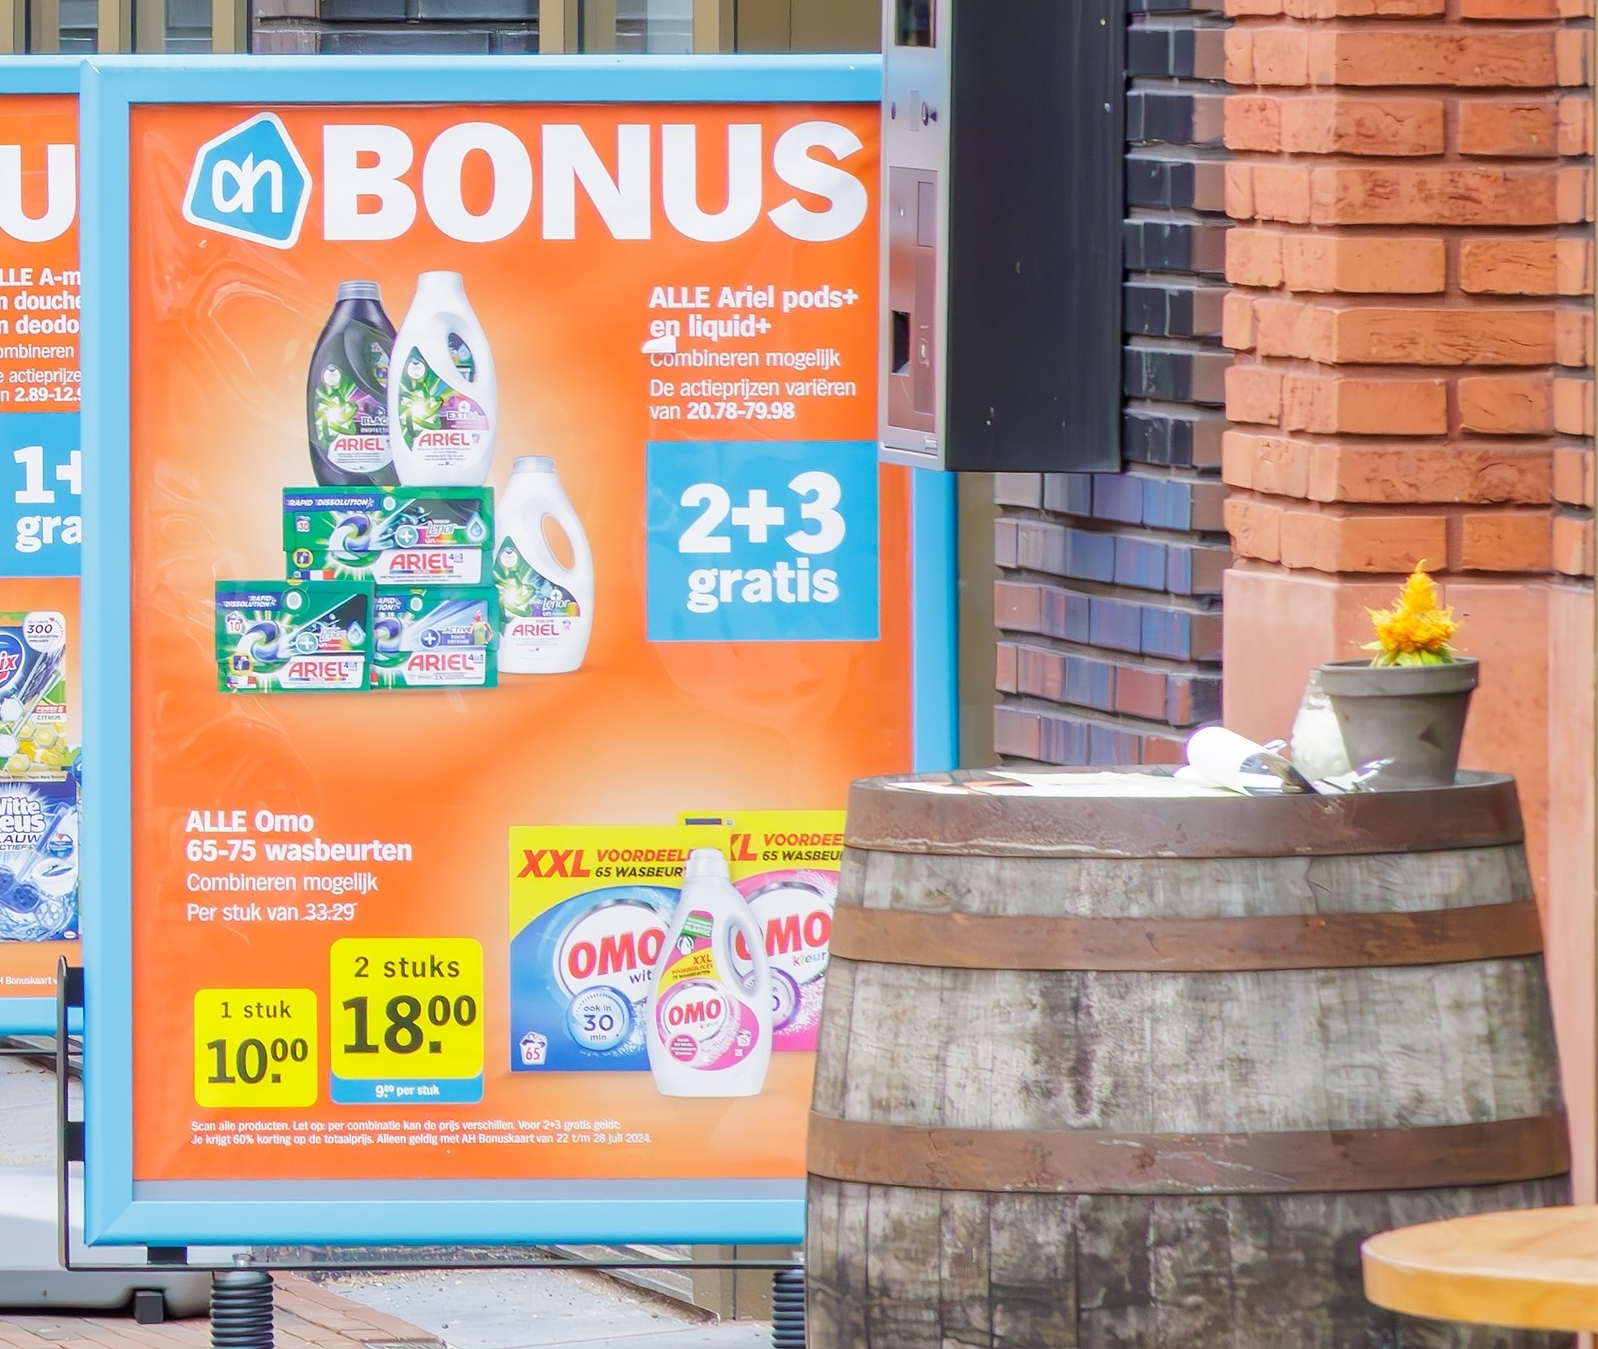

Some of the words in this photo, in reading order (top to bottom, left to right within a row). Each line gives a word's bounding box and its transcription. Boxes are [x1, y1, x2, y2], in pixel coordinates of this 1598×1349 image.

[323, 121, 869, 243] BONUS
[39, 268, 81, 286] A-m
[649, 287, 710, 309] ALLE
[717, 285, 774, 309] Ariel
[782, 285, 859, 313] pods+
[15, 315, 80, 335] deodo
[650, 319, 680, 338] en
[689, 314, 771, 342] liquid+
[650, 349, 759, 367] Combineren
[766, 348, 841, 370] mogelijk
[650, 379, 674, 397] De
[681, 378, 779, 399] actieprijzen
[785, 379, 856, 397] variëren
[649, 404, 681, 420] van
[687, 401, 795, 420] 20.78-79.98
[418, 433, 470, 447] ARIEL
[678, 470, 846, 554] 2+3
[687, 557, 839, 613] gratis
[512, 624, 559, 636] ARIEL
[407, 654, 474, 671] ARIEL
[185, 810, 247, 832] ALLE
[255, 810, 314, 832] Omo
[187, 840, 256, 862] 65-75
[264, 839, 412, 862] wasbeurten
[517, 850, 591, 878] XXL
[596, 867, 611, 877] 65
[187, 873, 296, 892] Combineren
[303, 872, 378, 894] mogelijk
[187, 904, 217, 921] Per
[223, 903, 261, 921] stuk
[267, 906, 298, 921] van
[303, 903, 355, 921] 33.29
[354, 957, 369, 978] 2
[383, 955, 460, 978] stuks
[221, 1001, 232, 1018] 1
[243, 1000, 292, 1019] stuk
[668, 999, 721, 1026] OMO
[342, 994, 476, 1054] 18.00
[584, 1015, 614, 1031] 30
[207, 1038, 309, 1084] 10.00
[525, 1048, 540, 1060] 65
[396, 1086, 414, 1097] per
[417, 1084, 440, 1096] stuk
[191, 1121, 215, 1132] Scan
[218, 1121, 236, 1131] alle
[238, 1121, 290, 1133] producten.
